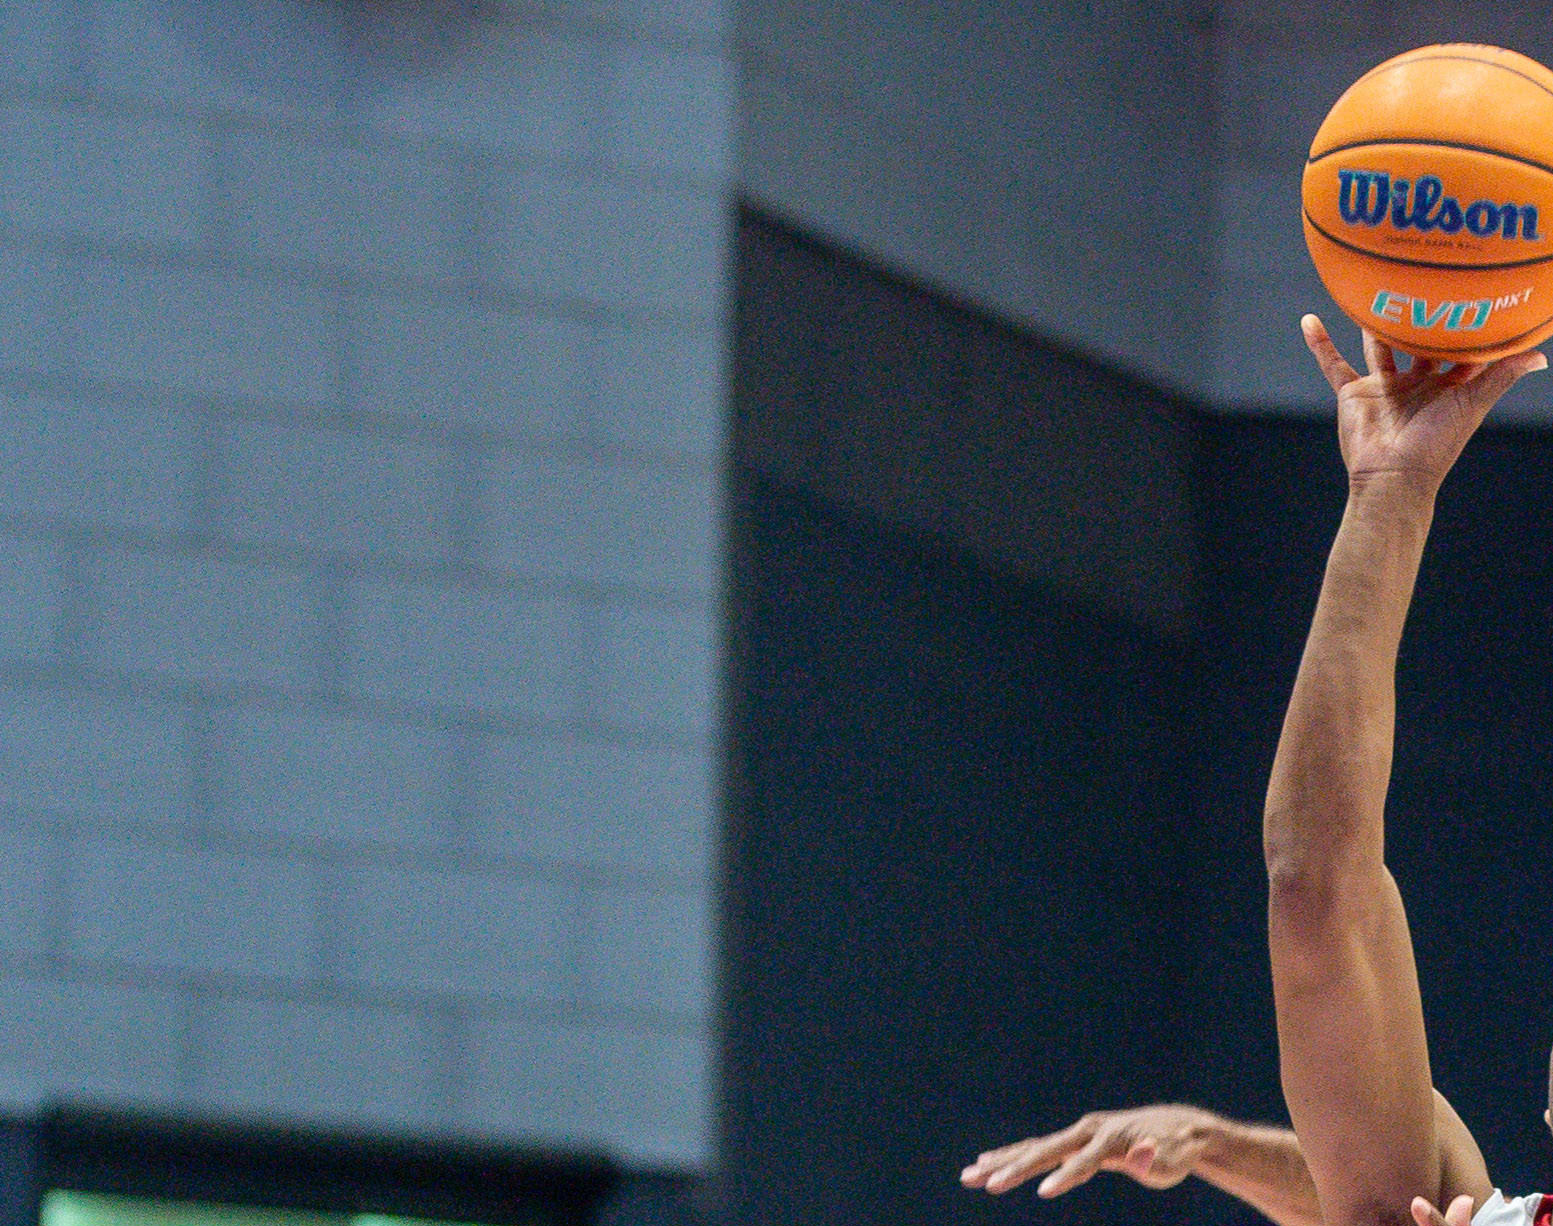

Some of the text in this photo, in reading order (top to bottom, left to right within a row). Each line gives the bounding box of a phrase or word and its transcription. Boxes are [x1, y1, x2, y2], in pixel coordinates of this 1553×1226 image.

[1338, 168, 1541, 241] Wilson
[1370, 286, 1535, 331] EVO NXT
